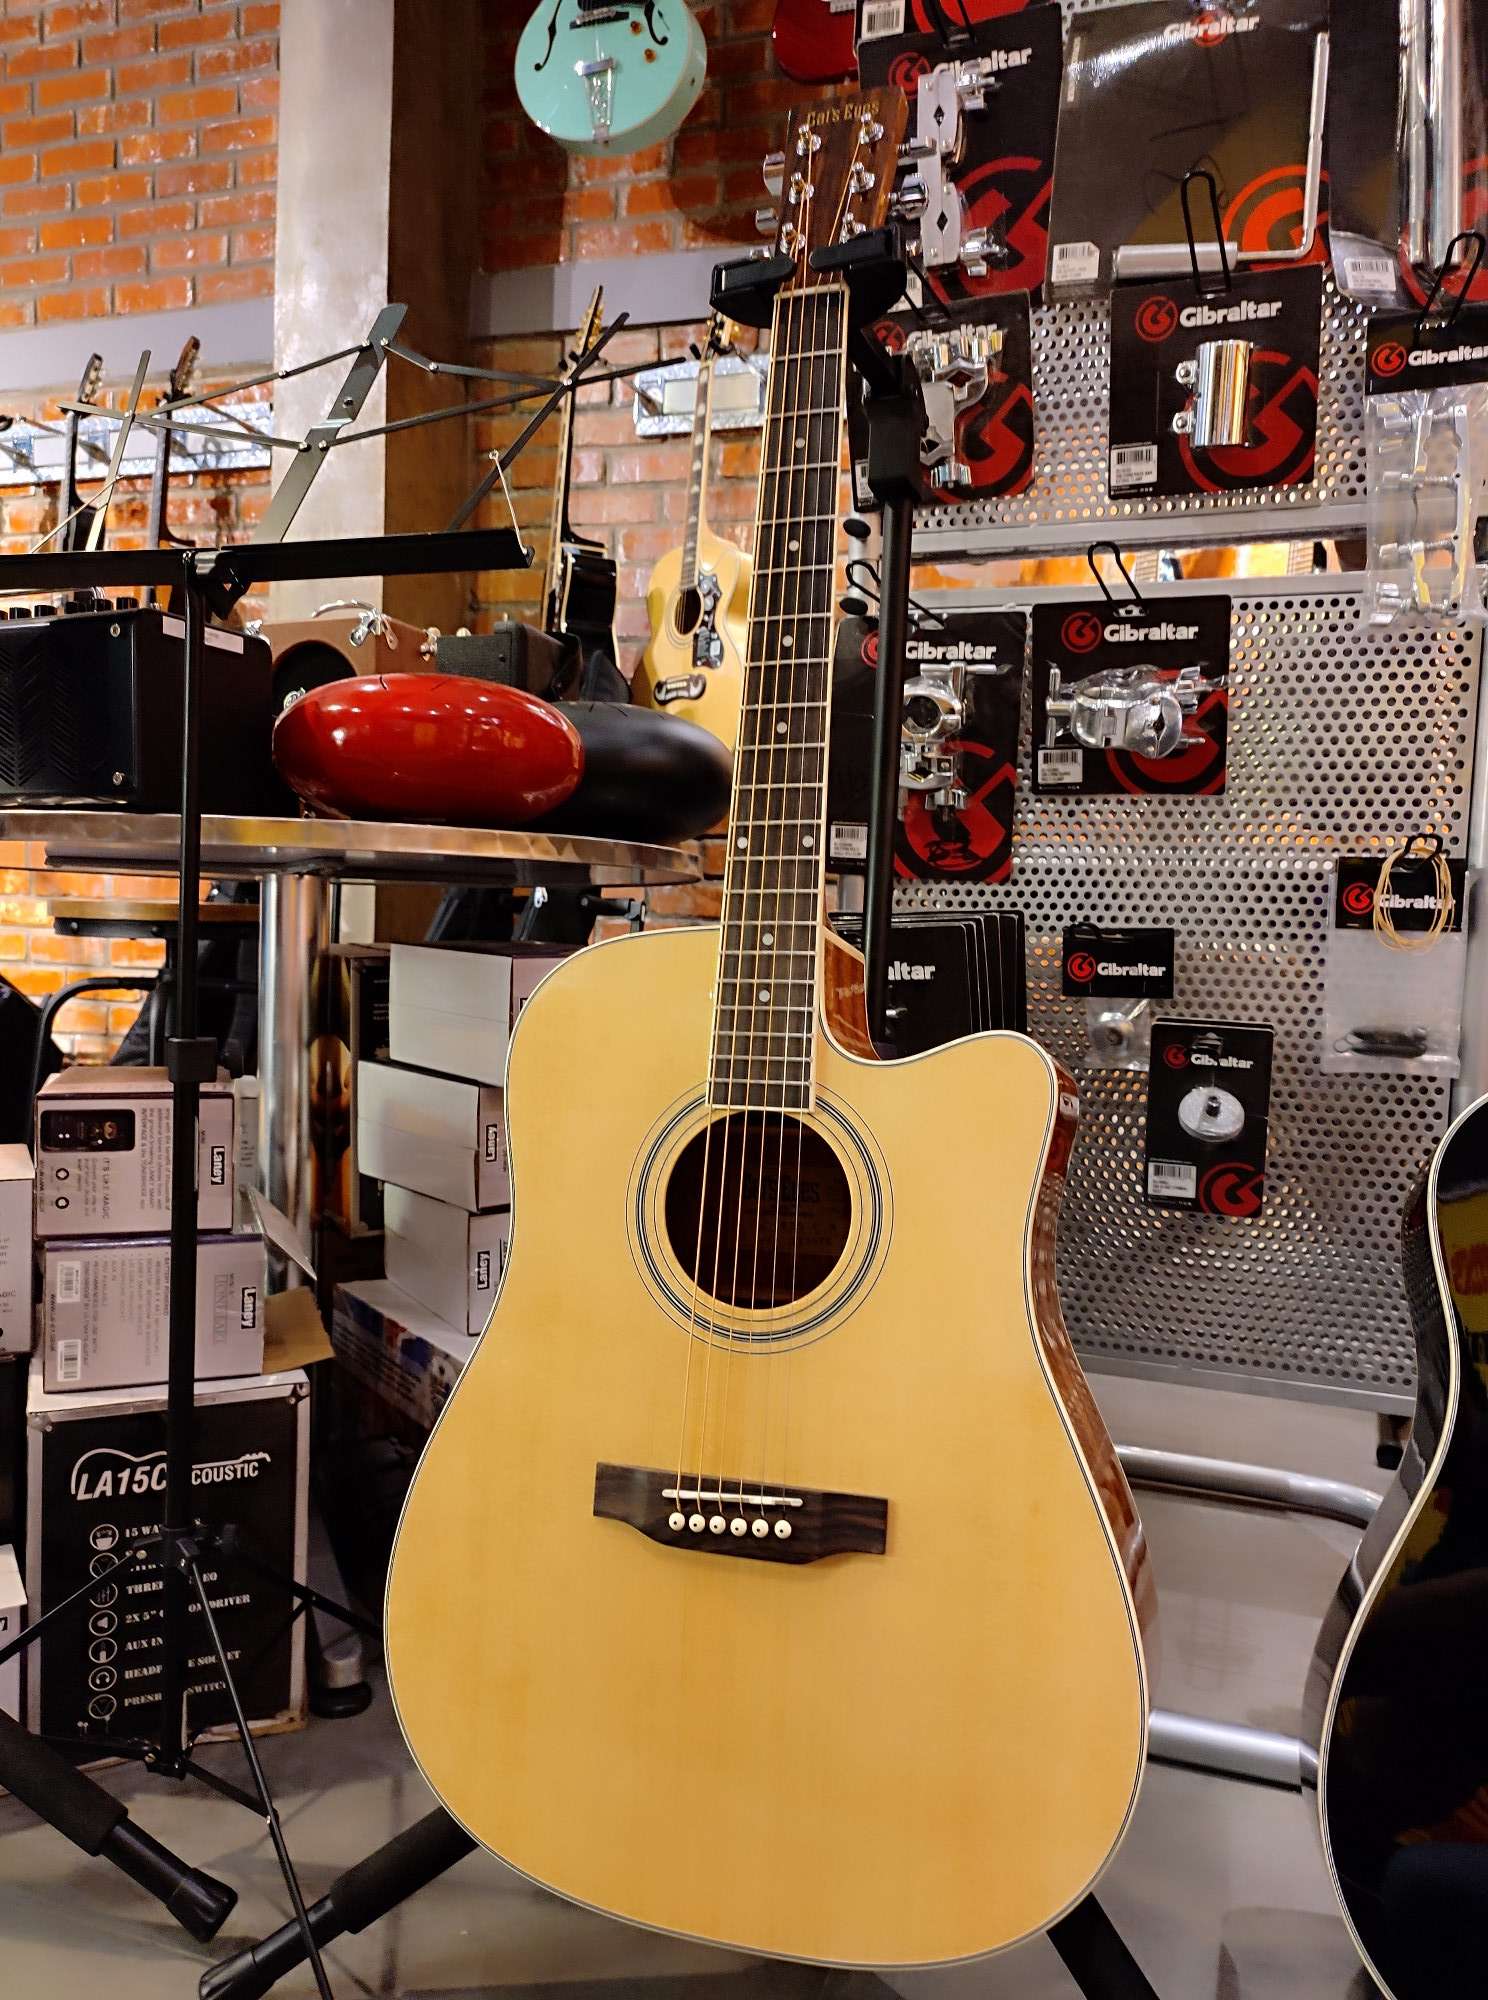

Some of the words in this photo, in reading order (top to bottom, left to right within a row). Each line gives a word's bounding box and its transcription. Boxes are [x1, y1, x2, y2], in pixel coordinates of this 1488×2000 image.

[1163, 15, 1260, 40] Gibraltar
[933, 47, 1032, 80] Gibaltar
[1180, 300, 1283, 327] Gibraltar
[1104, 623, 1199, 642] Gibraltar
[905, 640, 997, 661] Gibraltar
[1097, 963, 1166, 976] Gibraltar
[1190, 1053, 1254, 1069] Gibaltar
[486, 1126, 497, 1161] Laney
[211, 1147, 225, 1183] Laney
[477, 1253, 490, 1289] Laney
[242, 1288, 256, 1327] Laney
[191, 1461, 259, 1486] COUSTIC
[125, 1527, 139, 1537] 15
[125, 1640, 148, 1650] AUX
